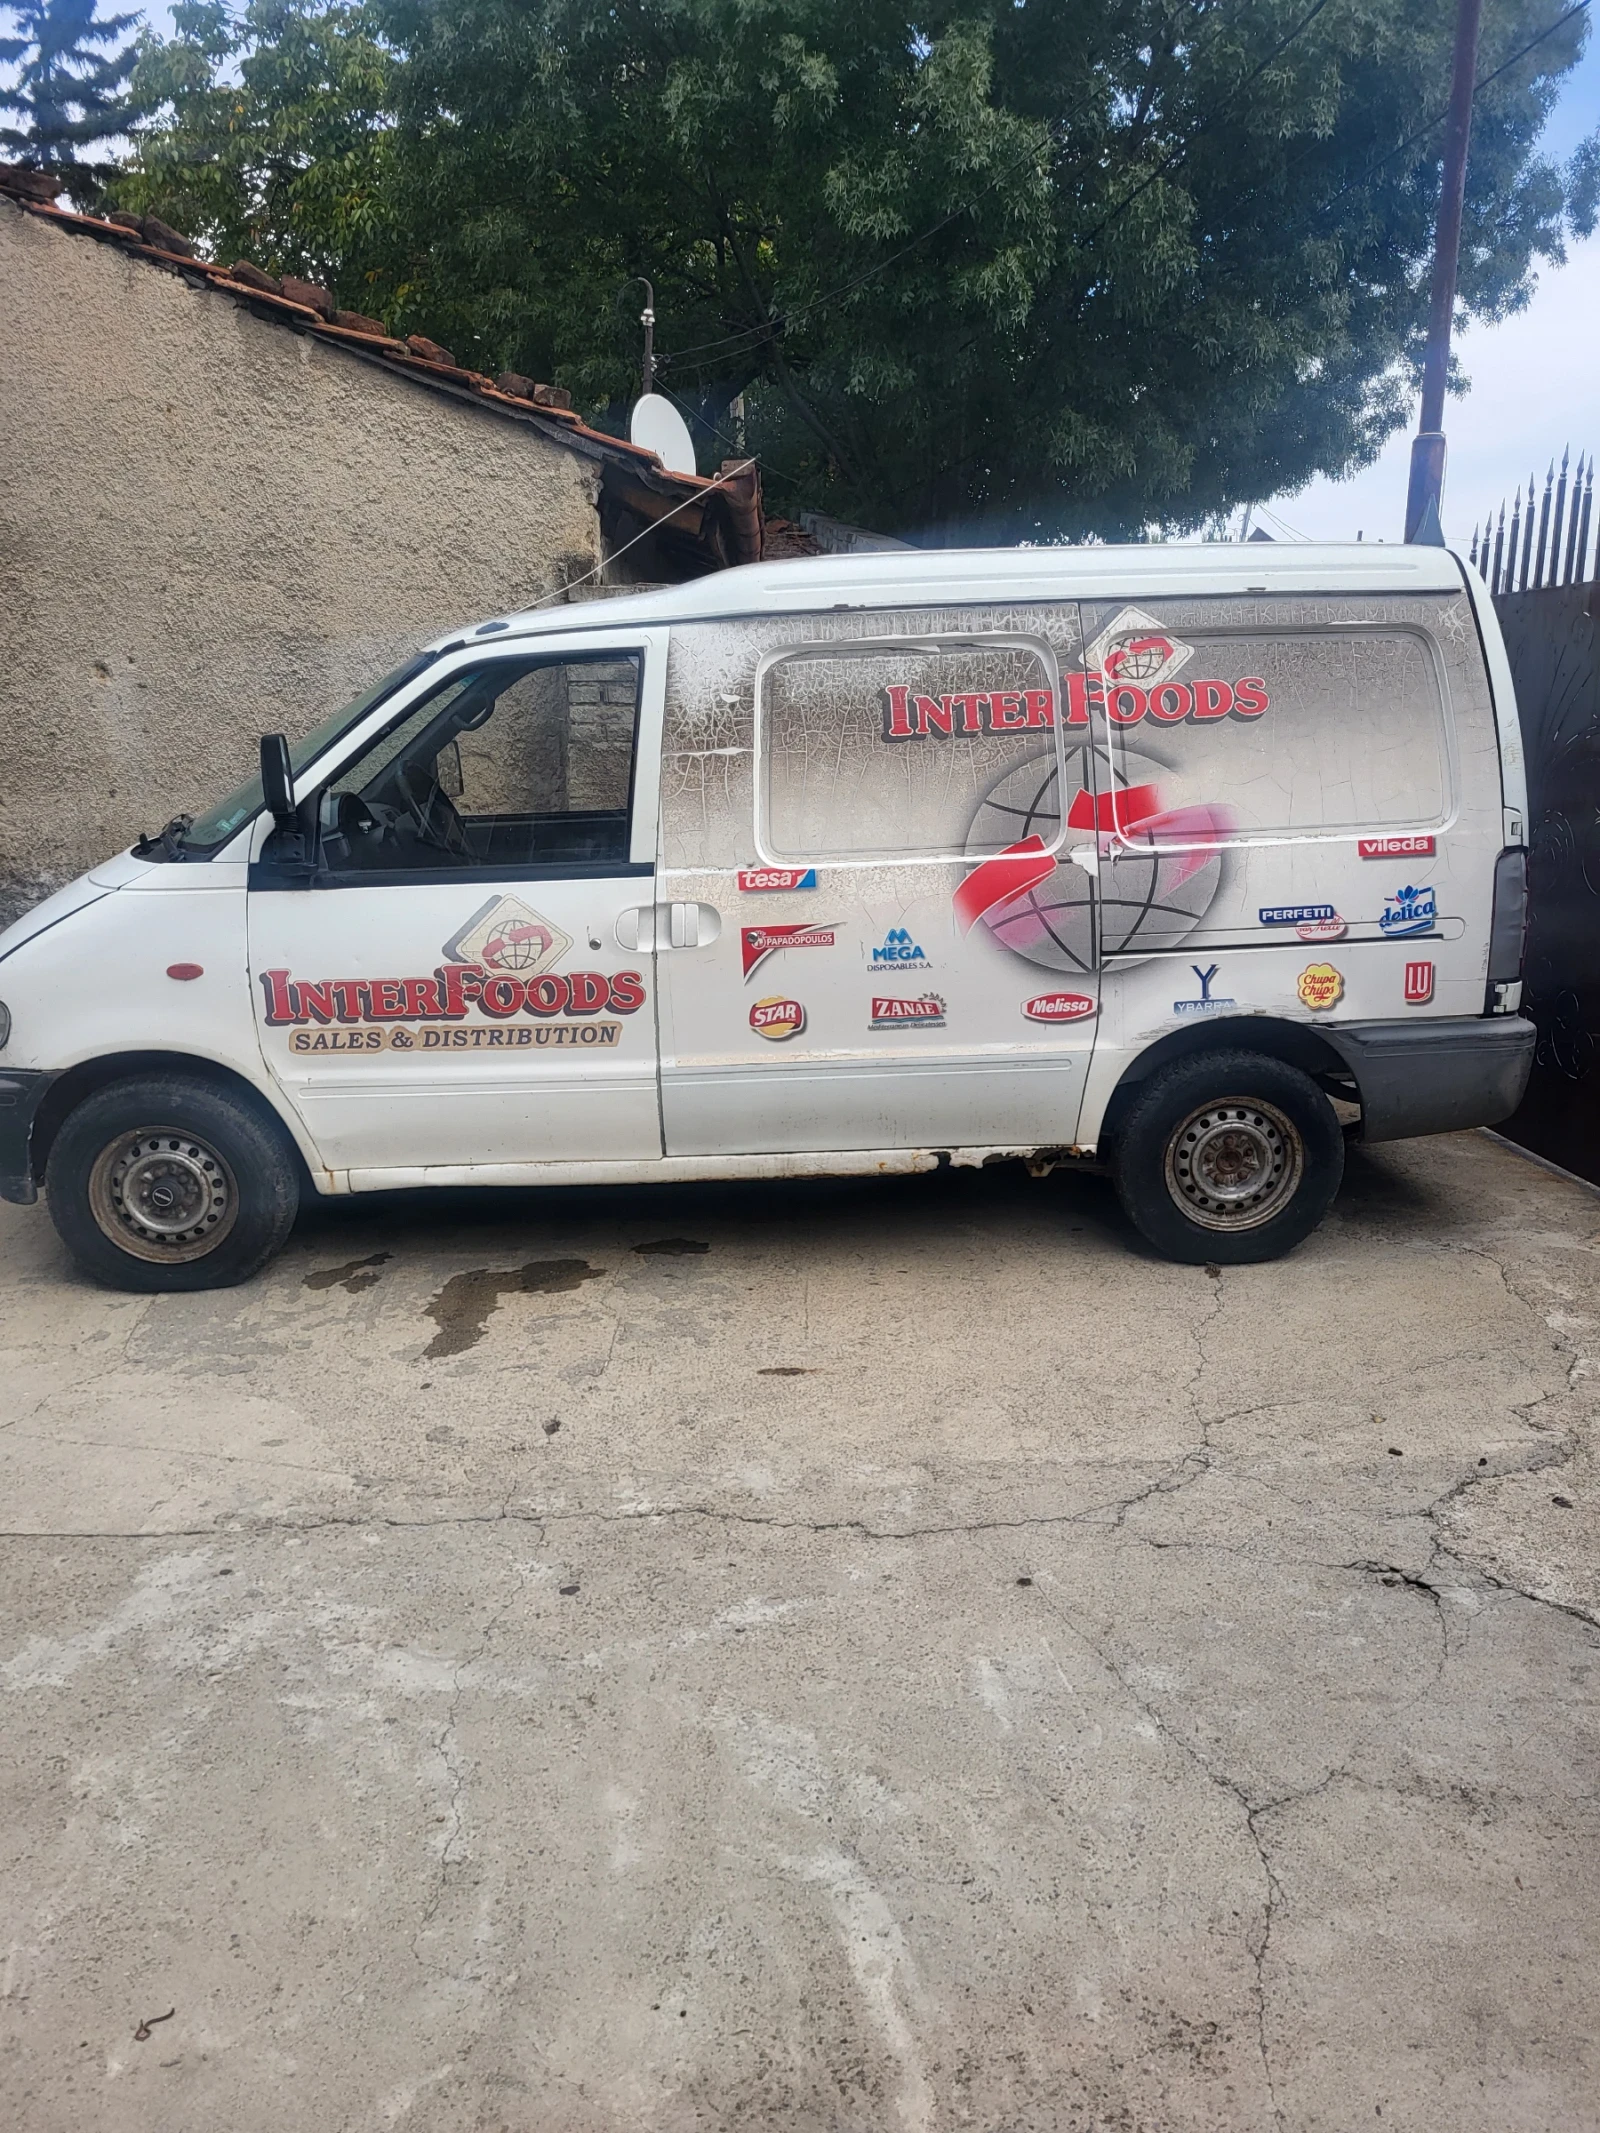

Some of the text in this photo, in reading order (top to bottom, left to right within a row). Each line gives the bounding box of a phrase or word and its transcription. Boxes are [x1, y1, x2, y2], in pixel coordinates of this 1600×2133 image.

[1363, 837, 1429, 853] vileda
[741, 871, 792, 888] tesa
[1262, 907, 1331, 921] PERFETTI
[1379, 901, 1436, 928] delica
[766, 934, 833, 947] PAPADOPOULOS
[872, 945, 926, 962] MEGA
[866, 961, 934, 972] DISPOSABLES S.A.
[1303, 974, 1336, 987] Chupa
[1408, 965, 1429, 994] LU
[1302, 985, 1335, 1002] Chups
[876, 1000, 935, 1017] ZANAE
[1031, 997, 1089, 1014] Melissa
[1177, 1001, 1233, 1013] YBARRA
[754, 1004, 797, 1026] STAR
[294, 1024, 618, 1051] SALES & DISTRIBUTION
